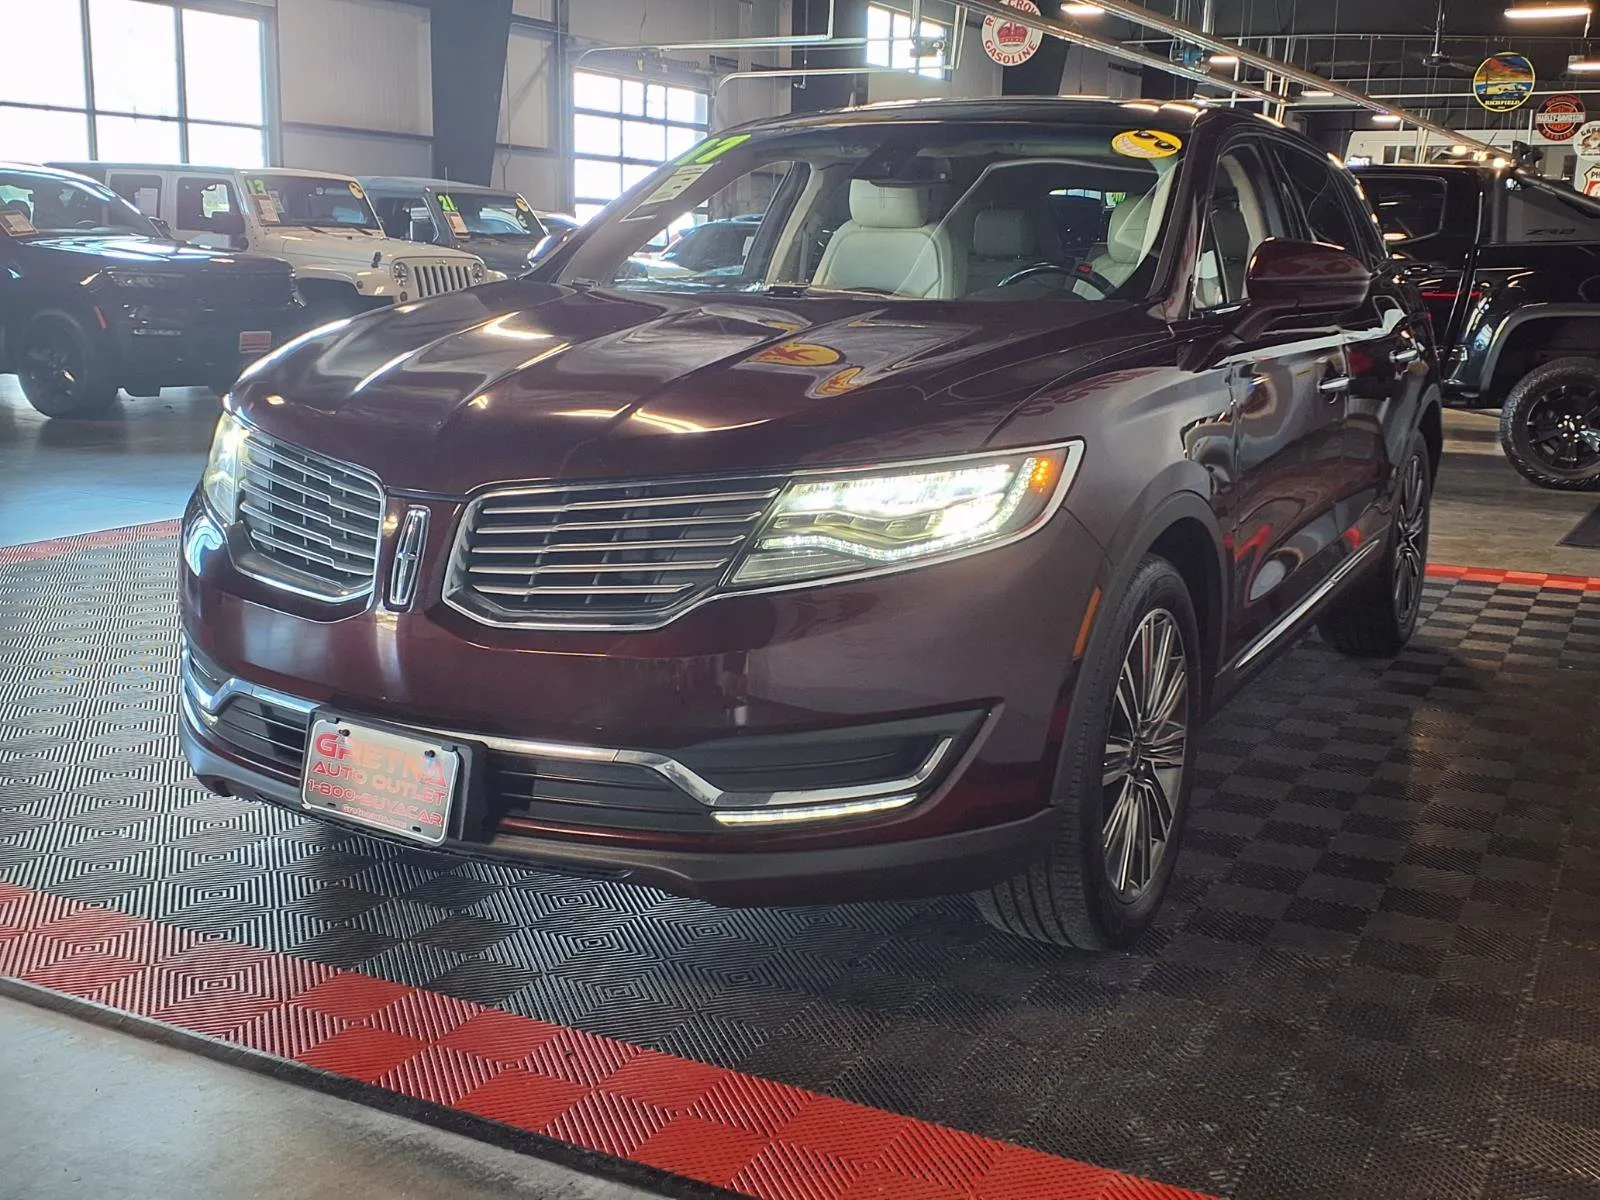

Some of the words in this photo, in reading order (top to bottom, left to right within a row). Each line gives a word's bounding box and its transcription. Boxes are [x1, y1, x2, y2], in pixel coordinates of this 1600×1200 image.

[985, 40, 1037, 64] GASOLINE
[315, 733, 447, 787] GRETNA
[311, 761, 368, 785] AUTO
[372, 774, 447, 806] OUTLET
